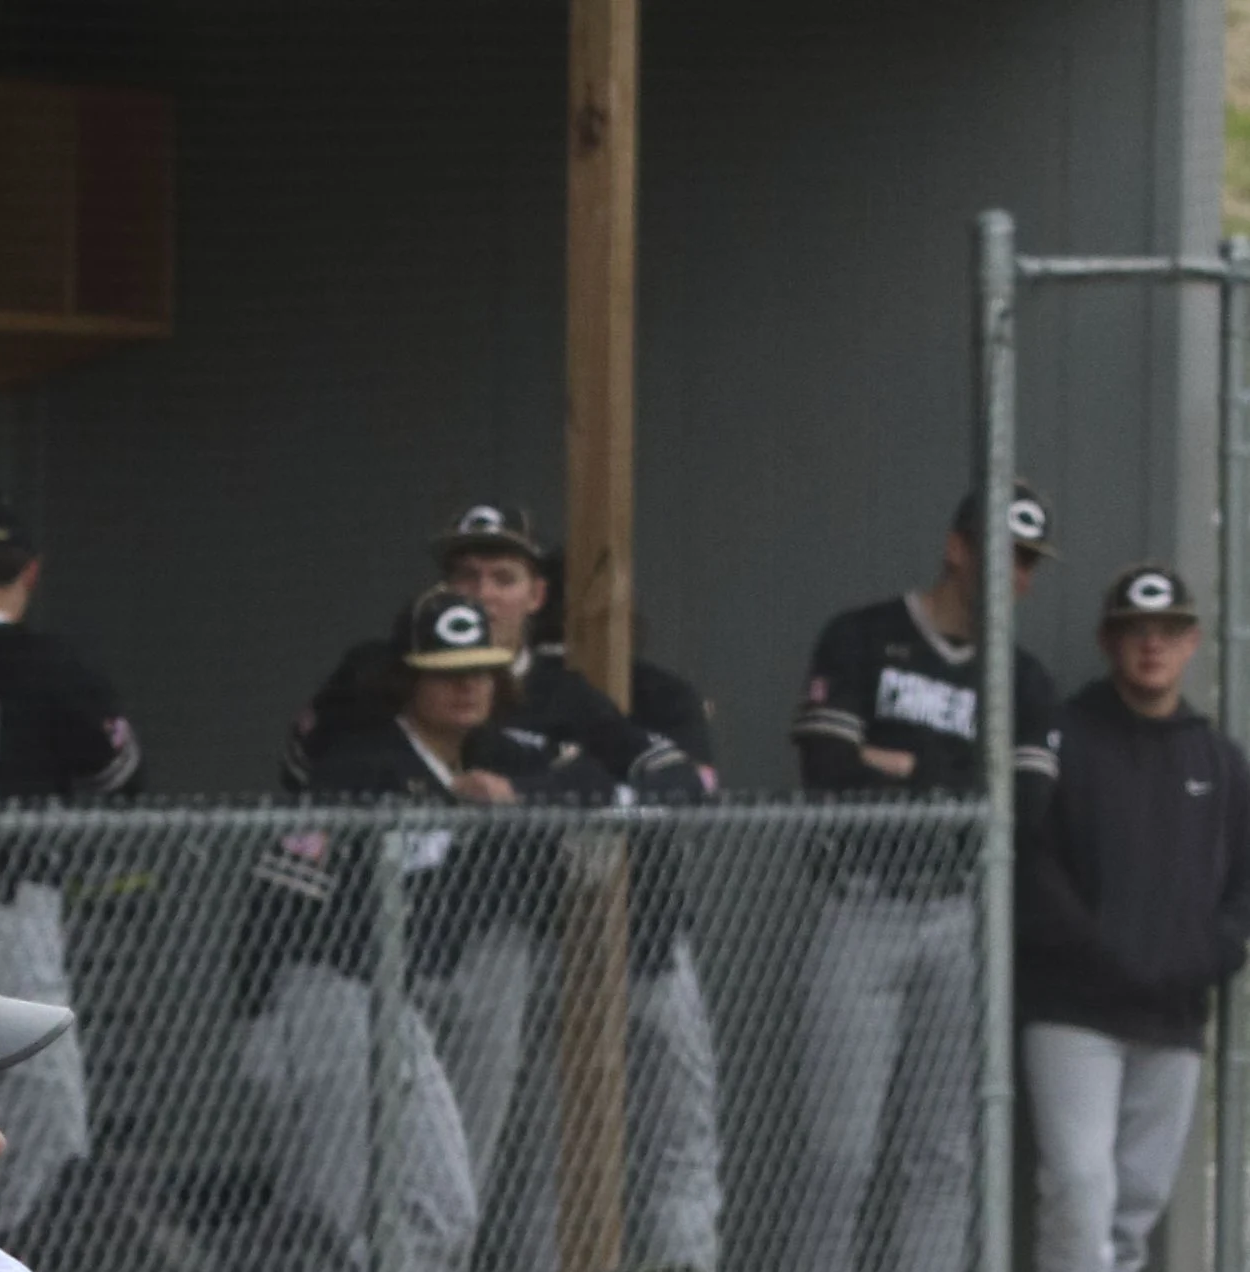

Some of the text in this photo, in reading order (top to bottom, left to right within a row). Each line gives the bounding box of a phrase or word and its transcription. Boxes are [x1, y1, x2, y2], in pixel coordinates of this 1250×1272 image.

[1007, 499, 1046, 539] C
[1126, 572, 1174, 611] C
[435, 604, 483, 645] C
